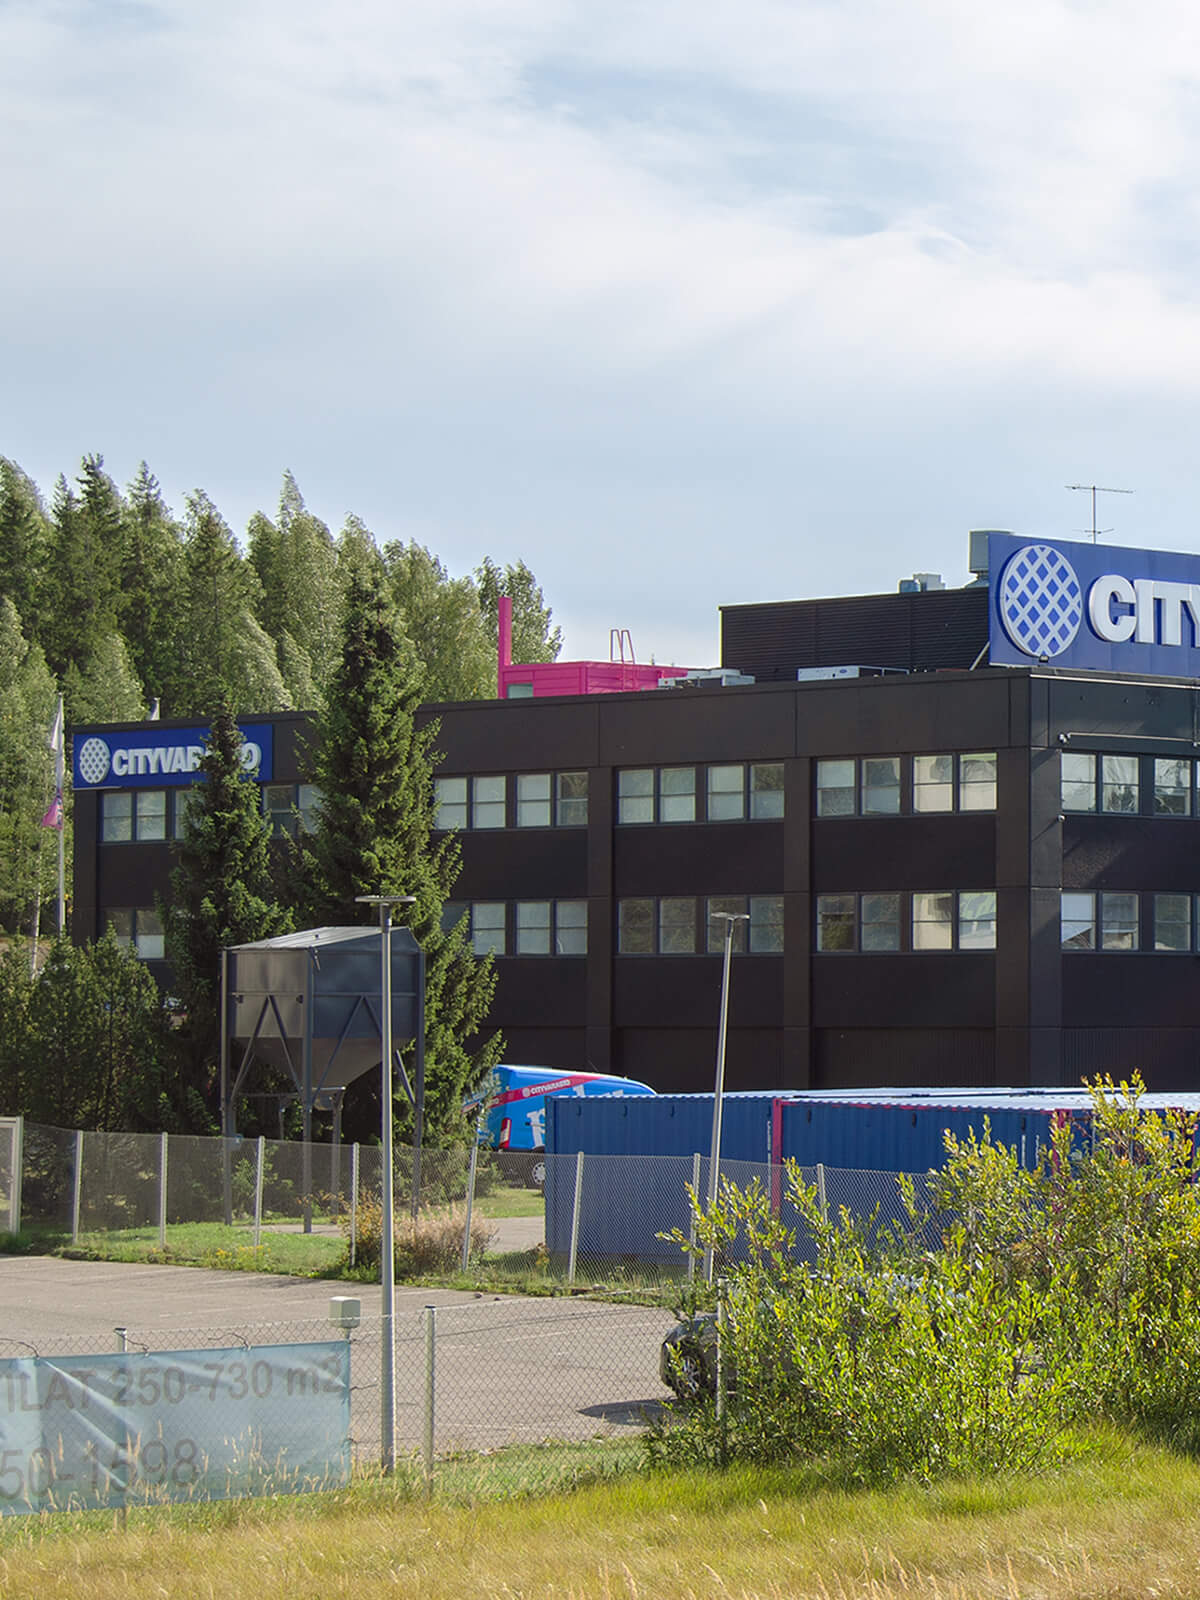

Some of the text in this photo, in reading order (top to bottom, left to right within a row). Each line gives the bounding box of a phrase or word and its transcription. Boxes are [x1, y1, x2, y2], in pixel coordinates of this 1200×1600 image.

[112, 742, 262, 776] CITYVARO
[0, 1368, 96, 1413] ILAT
[112, 1359, 273, 1408] 250-730
